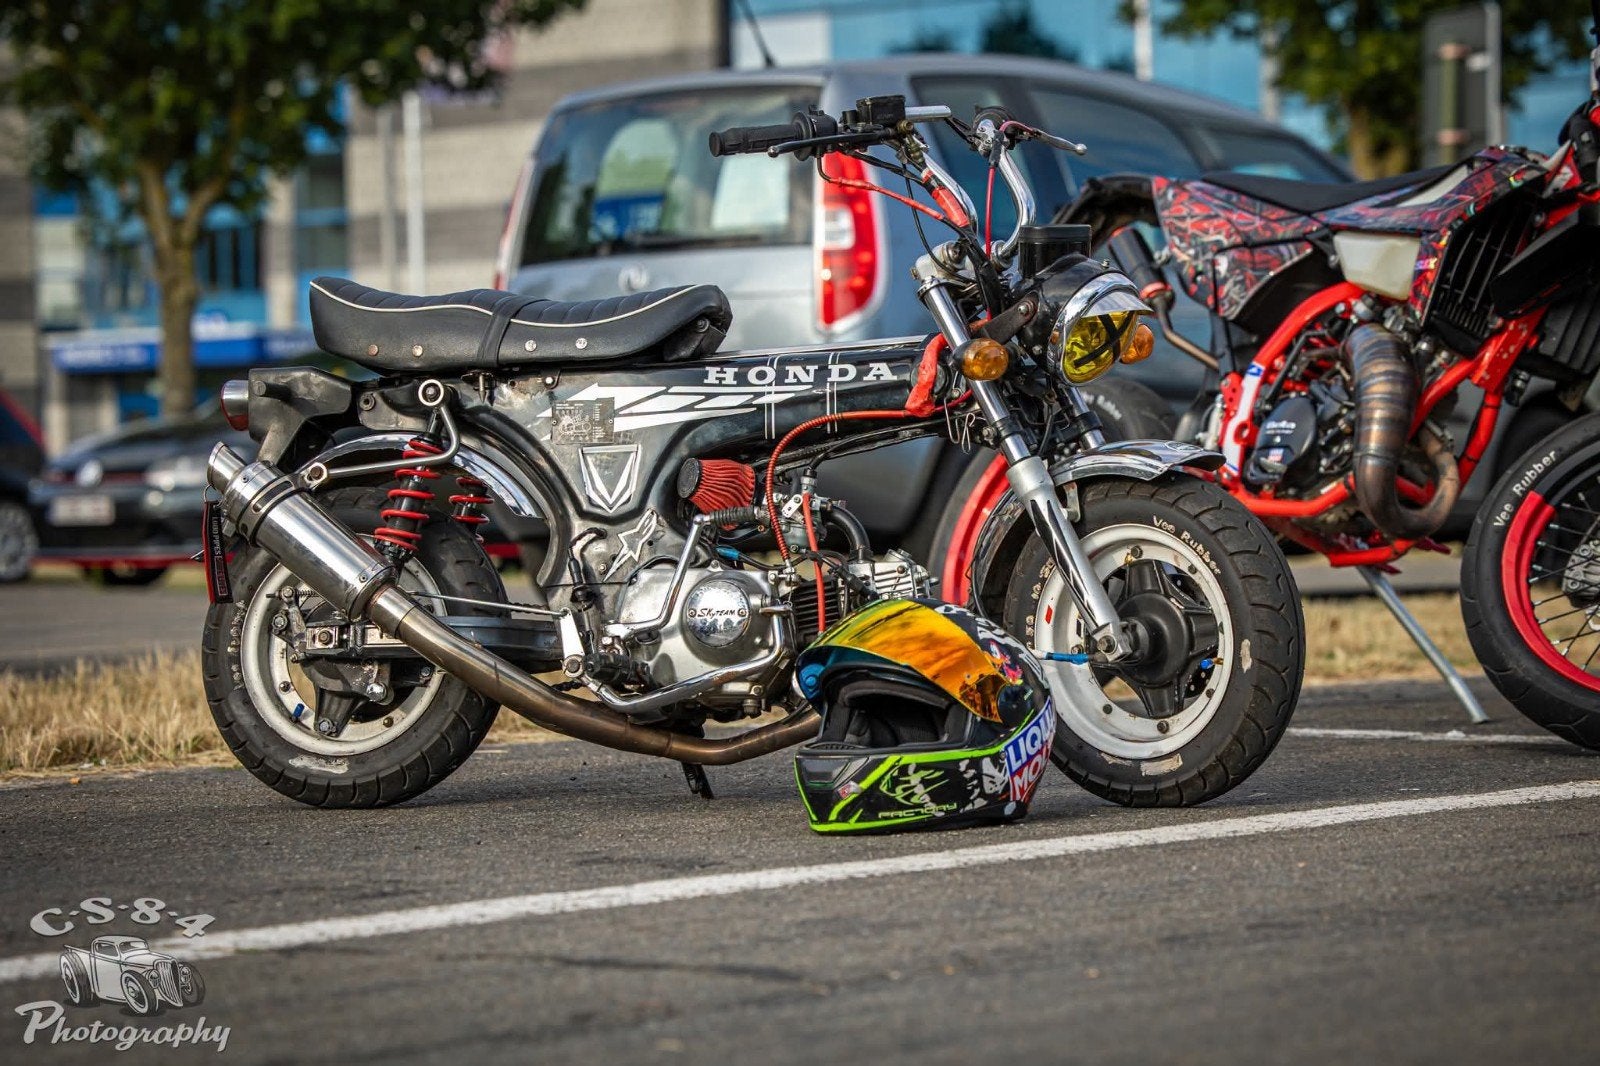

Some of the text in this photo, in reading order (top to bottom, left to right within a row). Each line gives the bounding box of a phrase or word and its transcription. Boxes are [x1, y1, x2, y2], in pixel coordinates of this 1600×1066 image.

[703, 362, 898, 385] HONDA
[1493, 450, 1557, 526] Vee Rubber
[1153, 515, 1222, 575] Vee Rubber
[1014, 745, 1050, 802] MOL
